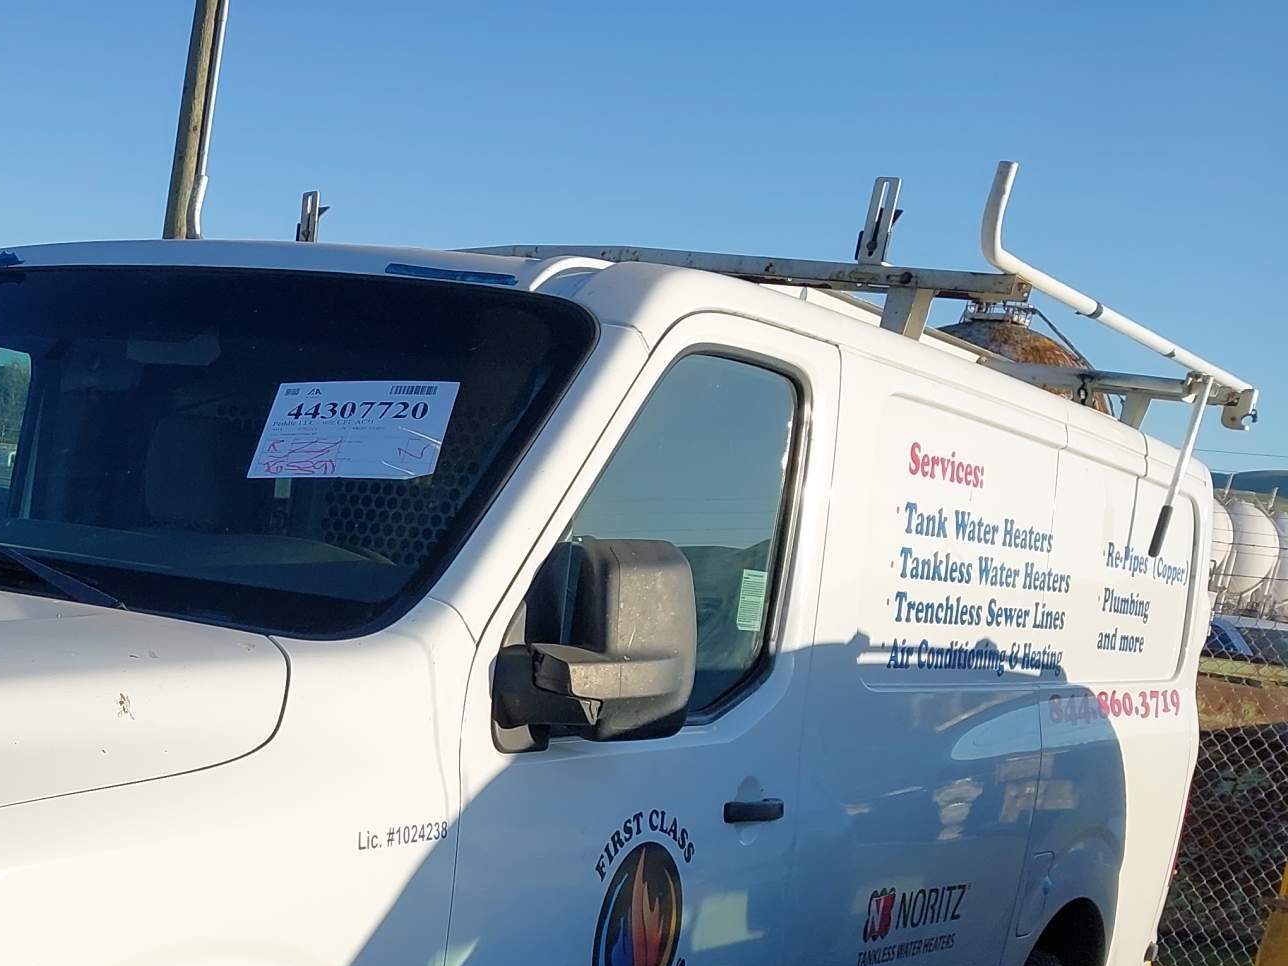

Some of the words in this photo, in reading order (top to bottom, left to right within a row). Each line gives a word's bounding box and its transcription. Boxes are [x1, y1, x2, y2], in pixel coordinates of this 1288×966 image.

[287, 401, 429, 420] 44307720
[909, 441, 985, 489] Services:
[904, 501, 949, 539] Tank
[954, 509, 1000, 547] Water
[1003, 518, 1054, 554] Heaters
[900, 546, 973, 584] Tankless
[978, 555, 1020, 590] Water
[1023, 562, 1072, 594] Heaters
[1152, 554, 1190, 586] (Copper)
[894, 590, 982, 626] Trenchless
[986, 597, 1030, 630] Sewer
[1032, 601, 1066, 631] Lines
[1101, 586, 1151, 623] Plumbing
[886, 637, 914, 669] Air
[1009, 641, 1020, 670] &
[1021, 642, 1064, 677] Heating
[1096, 628, 1118, 651] and
[1119, 633, 1145, 653] more
[358, 830, 383, 851] Lic.
[386, 820, 449, 848] #1024238
[595, 810, 644, 882] FIRST
[648, 808, 695, 864] CLASS
[895, 883, 969, 930] NORITZ
[897, 938, 924, 960] WATER
[924, 932, 956, 954] HEATERS
